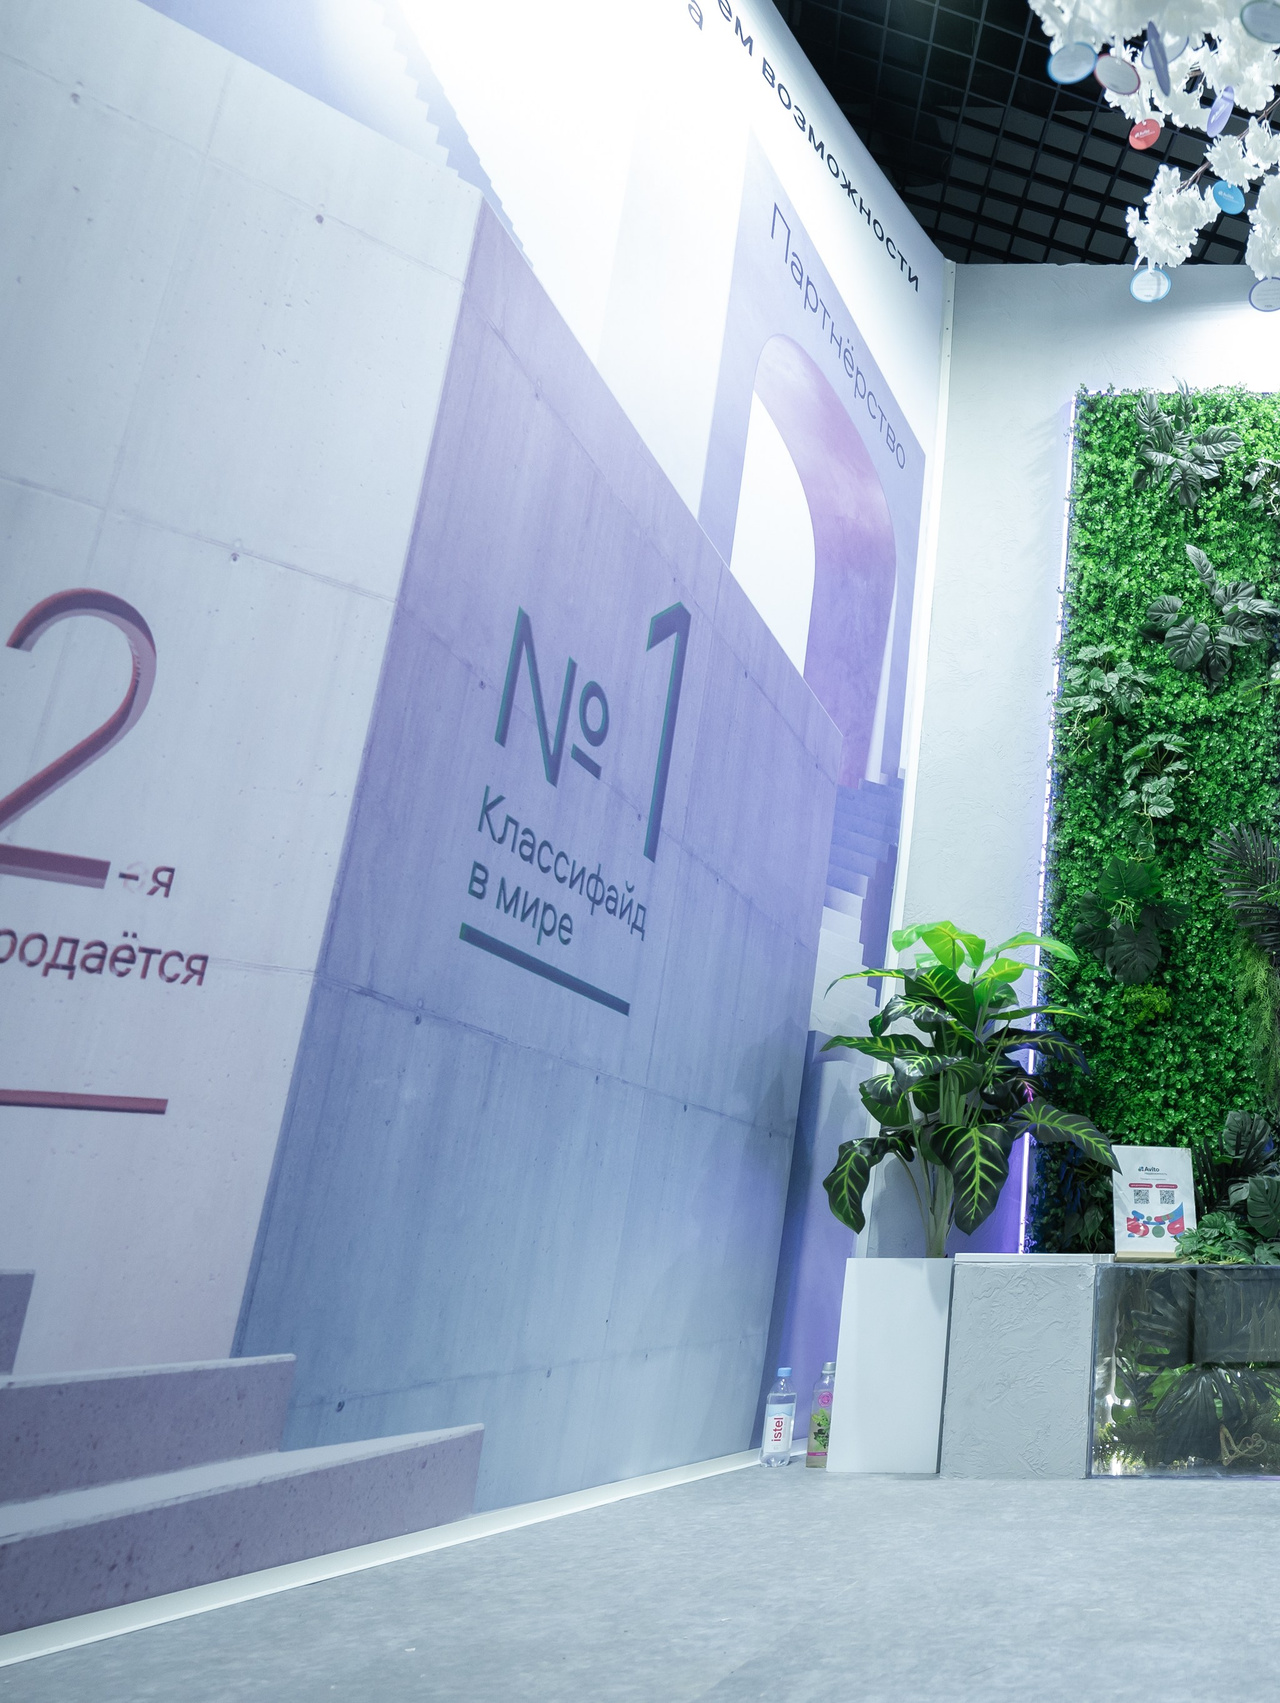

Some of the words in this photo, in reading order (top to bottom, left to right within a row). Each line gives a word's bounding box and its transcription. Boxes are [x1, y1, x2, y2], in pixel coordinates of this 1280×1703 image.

[762, 57, 919, 292] возможности
[771, 202, 905, 469] Партнёрство
[468, 861, 489, 900] в
[496, 877, 573, 945] мире
[478, 785, 647, 941] Классифайд
[771, 1417, 784, 1442] istel
